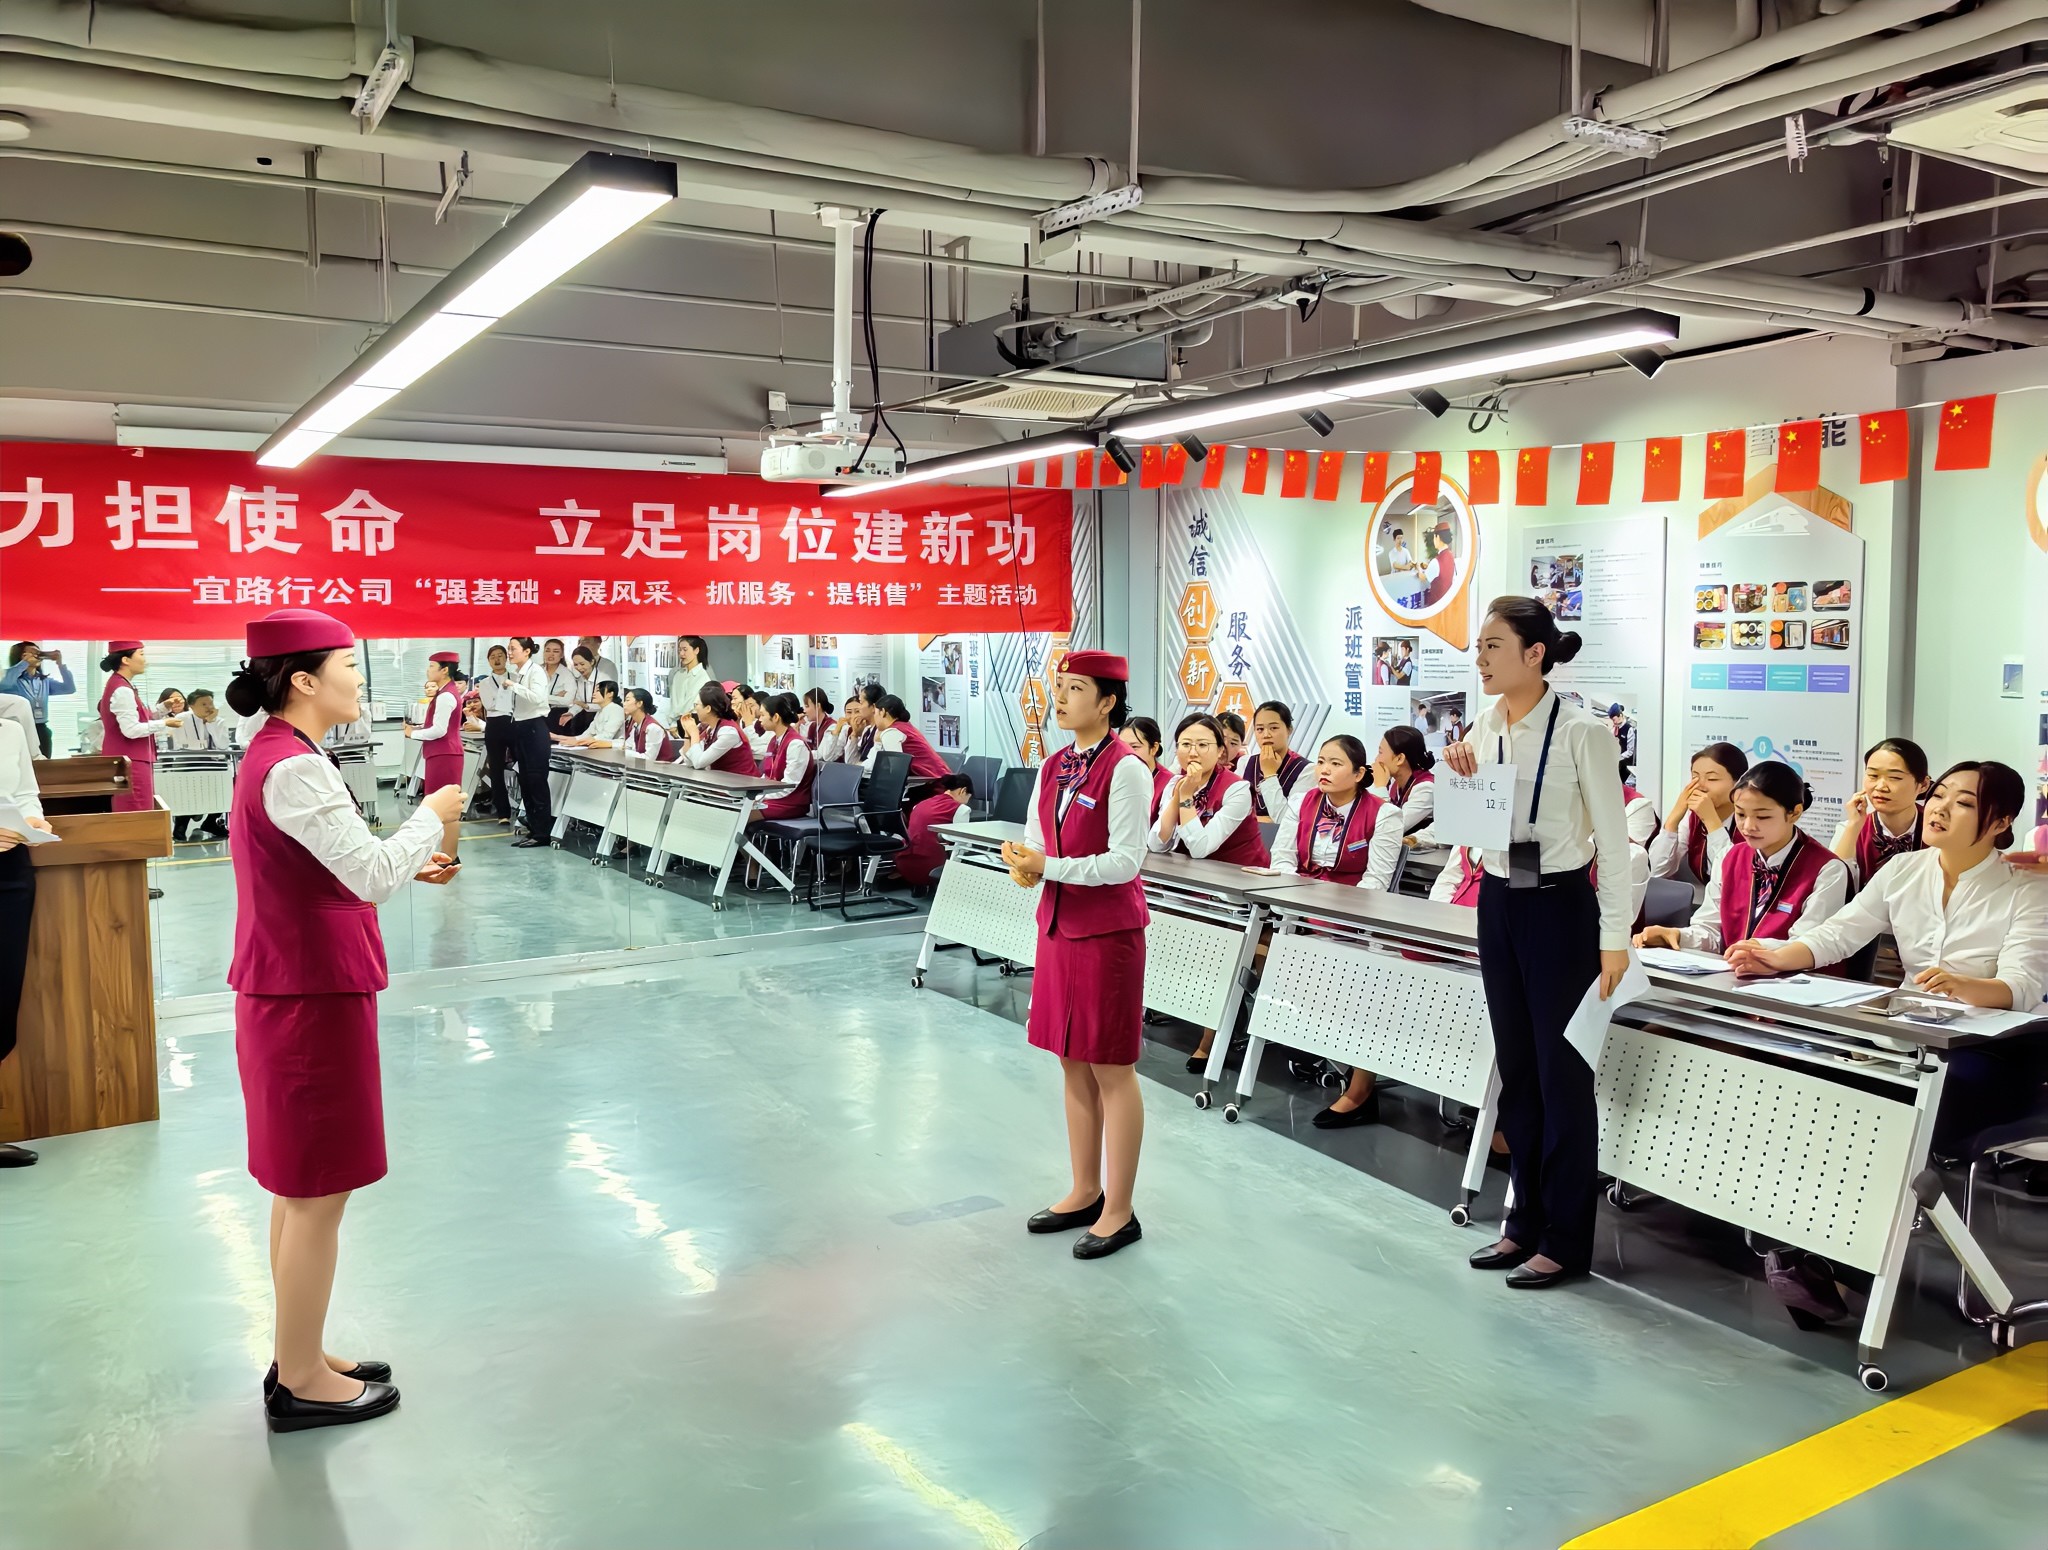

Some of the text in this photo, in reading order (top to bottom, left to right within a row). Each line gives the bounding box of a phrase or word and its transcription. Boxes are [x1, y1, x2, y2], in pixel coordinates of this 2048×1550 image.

[0, 477, 1036, 566] 力担使命 立足岗位建新功
[938, 583, 1037, 606] 主题活动
[1345, 605, 1363, 716] 派班管理
[1486, 799, 1495, 809] 12
